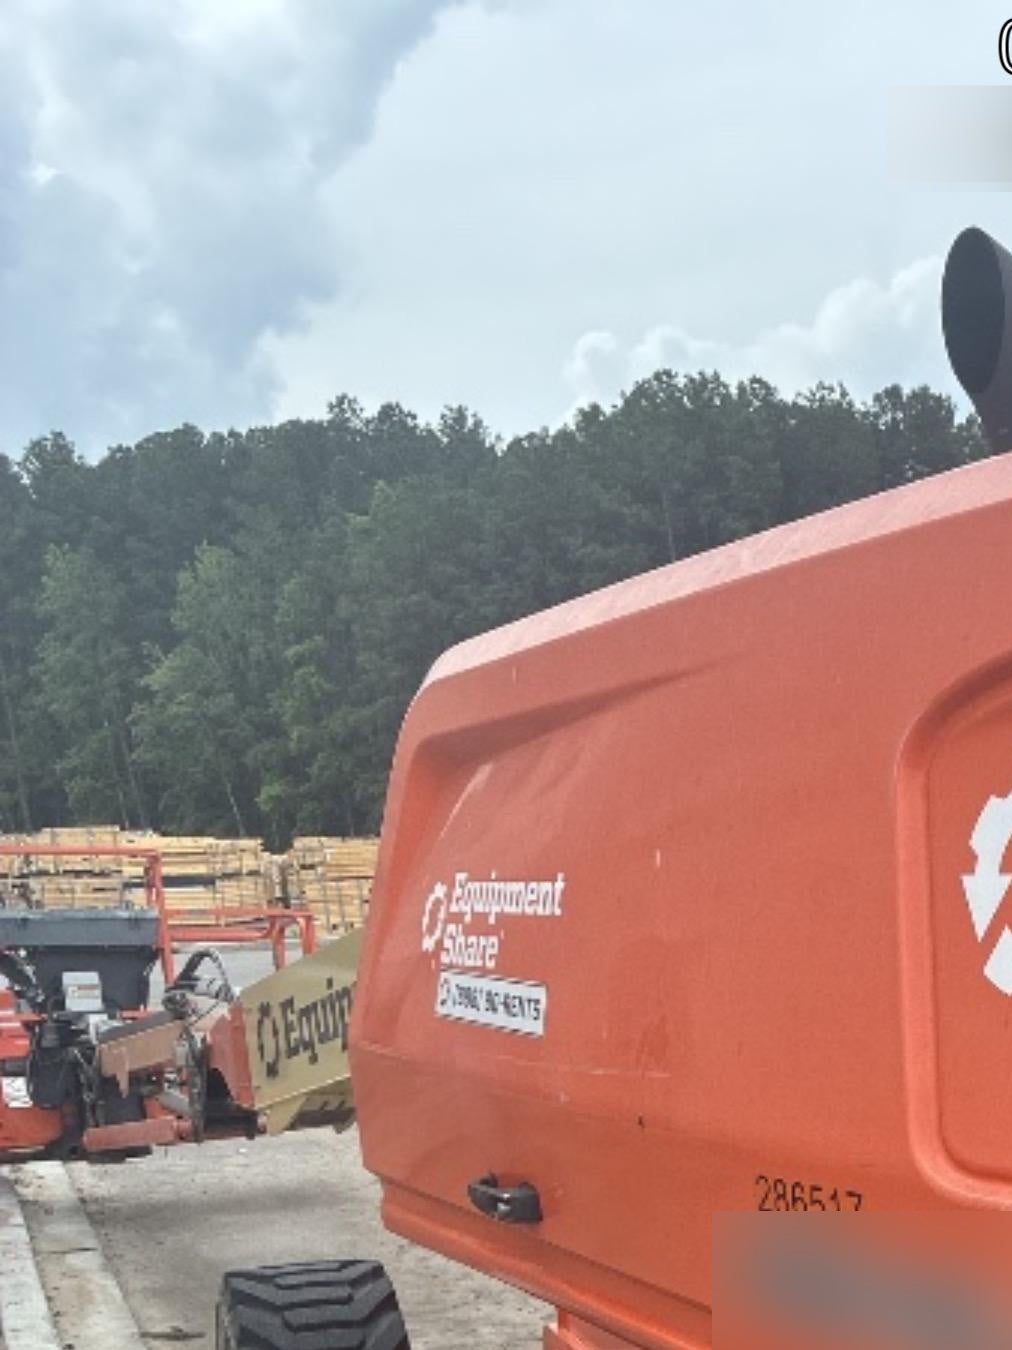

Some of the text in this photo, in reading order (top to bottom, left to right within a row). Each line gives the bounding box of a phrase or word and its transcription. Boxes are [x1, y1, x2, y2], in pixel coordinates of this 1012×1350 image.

[449, 869, 567, 925] Equipment
[440, 922, 499, 970] Share
[755, 1174, 863, 1212] 286517
